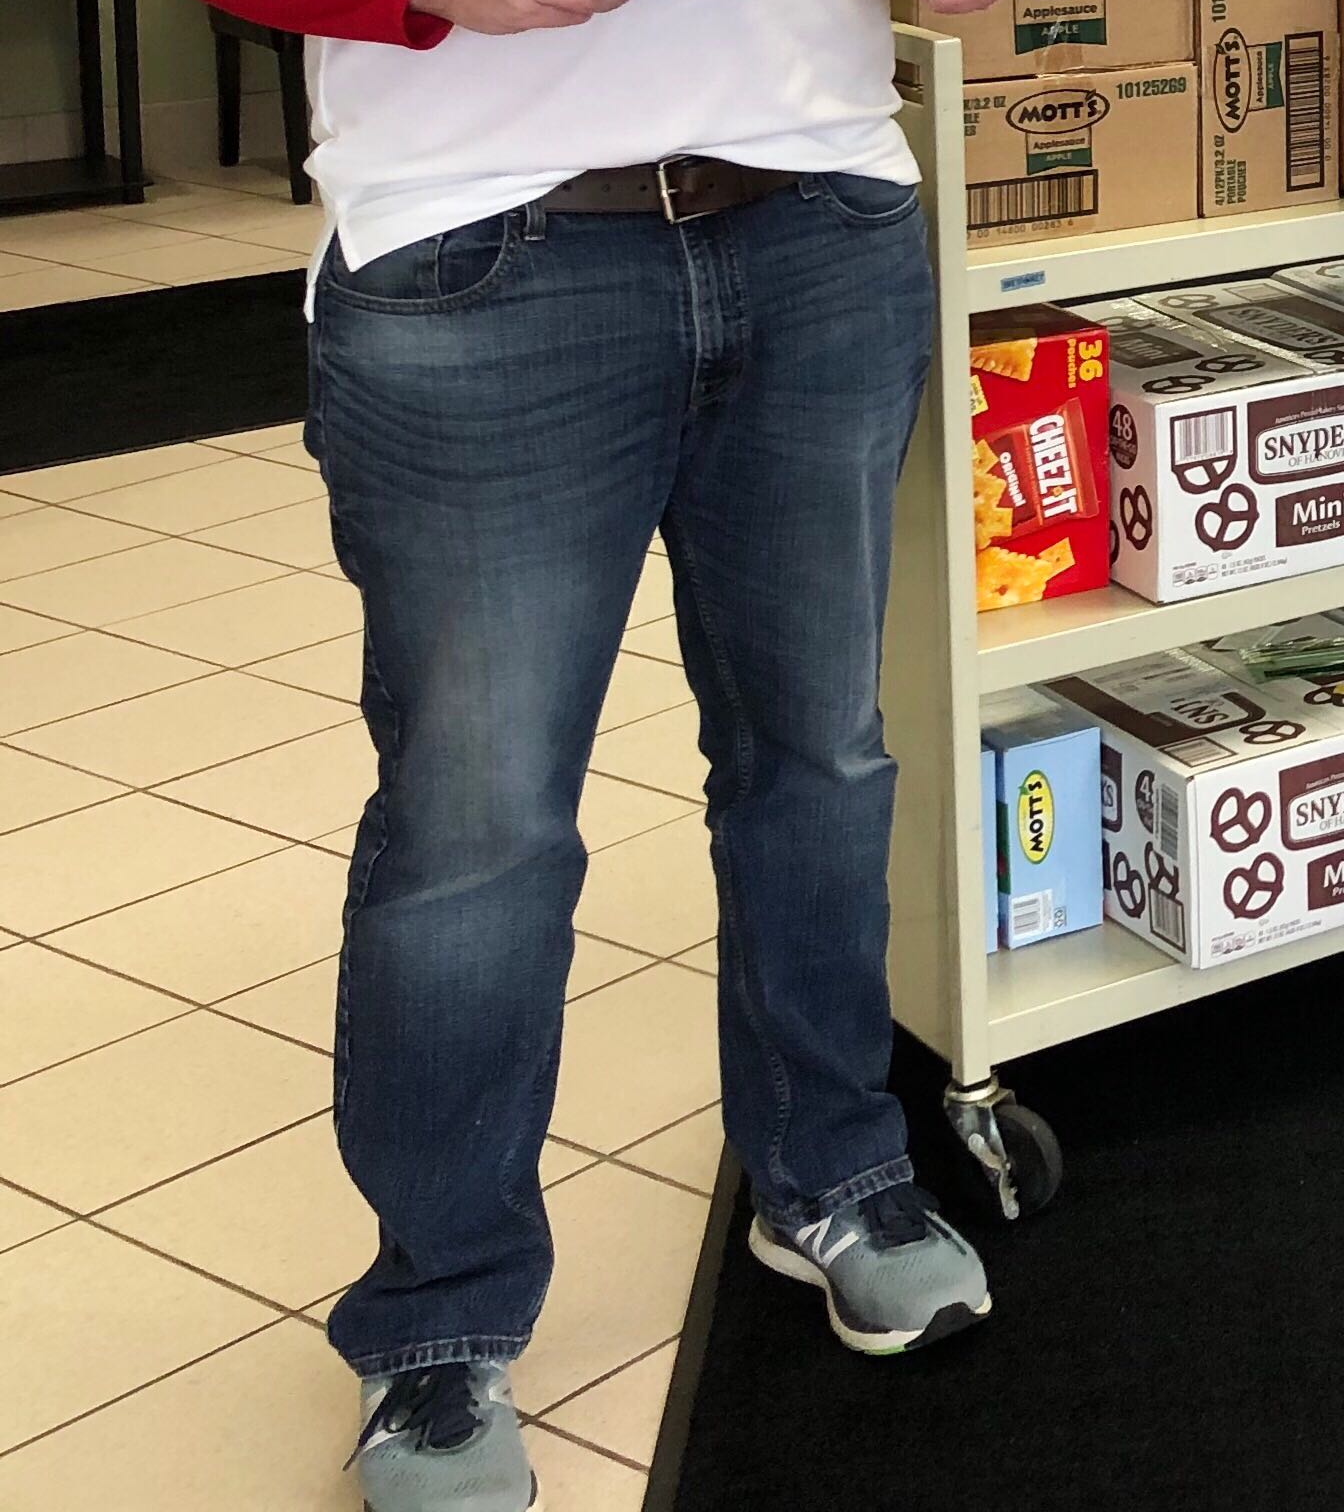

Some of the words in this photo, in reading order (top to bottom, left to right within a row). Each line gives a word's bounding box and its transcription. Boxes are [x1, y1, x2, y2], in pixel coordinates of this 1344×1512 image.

[1022, 2, 1098, 19] Applesauce
[1040, 23, 1080, 36] APPLE
[1115, 77, 1187, 100] 10125269
[1219, 38, 1242, 121] MOTT'S
[1255, 50, 1265, 104] Applesauce
[1018, 95, 1099, 125] MOTT'S
[1033, 137, 1086, 150] Applesauce
[1078, 339, 1104, 381] 36
[1112, 410, 1133, 441] 48
[1287, 454, 1303, 468] OF
[1301, 519, 1341, 536] Pretzels
[1026, 780, 1045, 853] MOTT'S
[1319, 818, 1334, 832] OF
